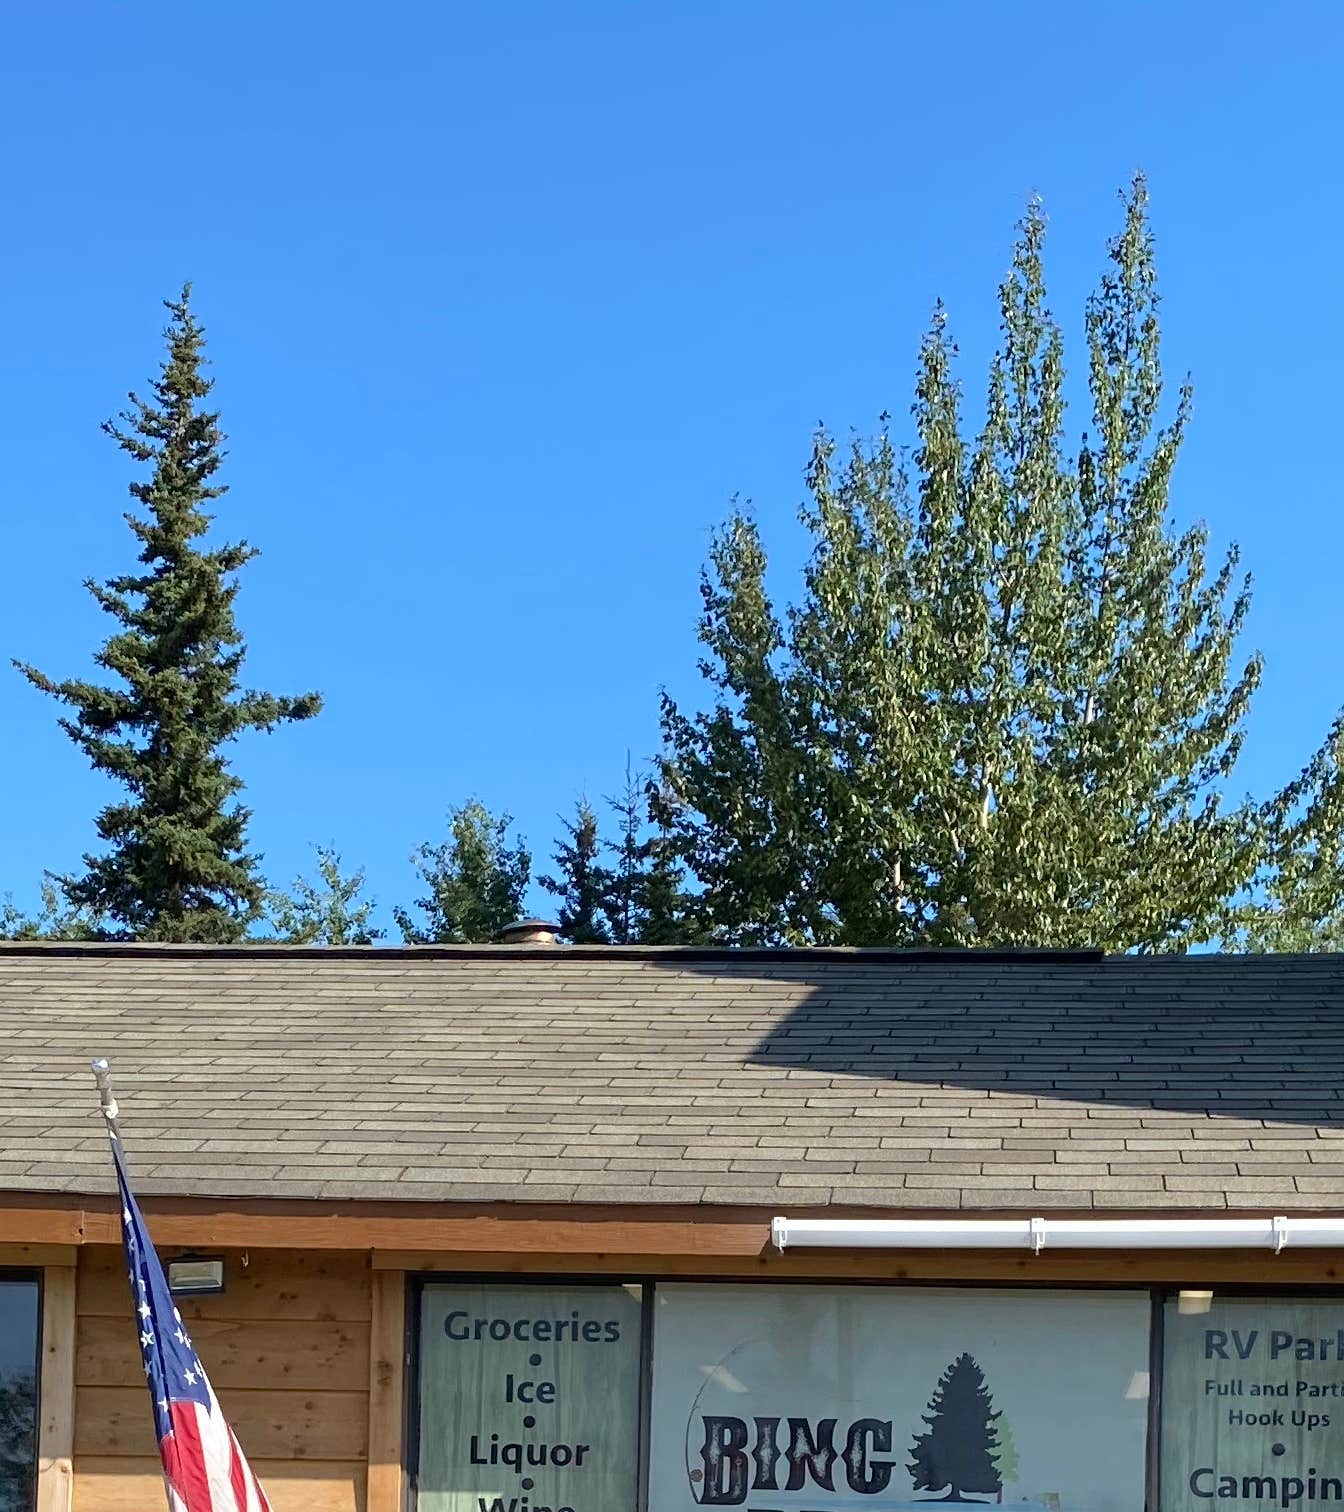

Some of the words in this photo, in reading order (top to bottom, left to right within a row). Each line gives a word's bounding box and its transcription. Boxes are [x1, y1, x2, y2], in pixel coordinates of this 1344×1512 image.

[444, 1311, 621, 1344] Groceries
[1204, 1330, 1259, 1361] RV
[505, 1374, 556, 1403] Ice
[1205, 1379, 1243, 1397] Full
[1250, 1380, 1289, 1397] and
[1229, 1410, 1285, 1427] Hook
[1292, 1411, 1331, 1432] Ups
[469, 1434, 590, 1474] Liquor
[699, 1415, 896, 1505] BING
